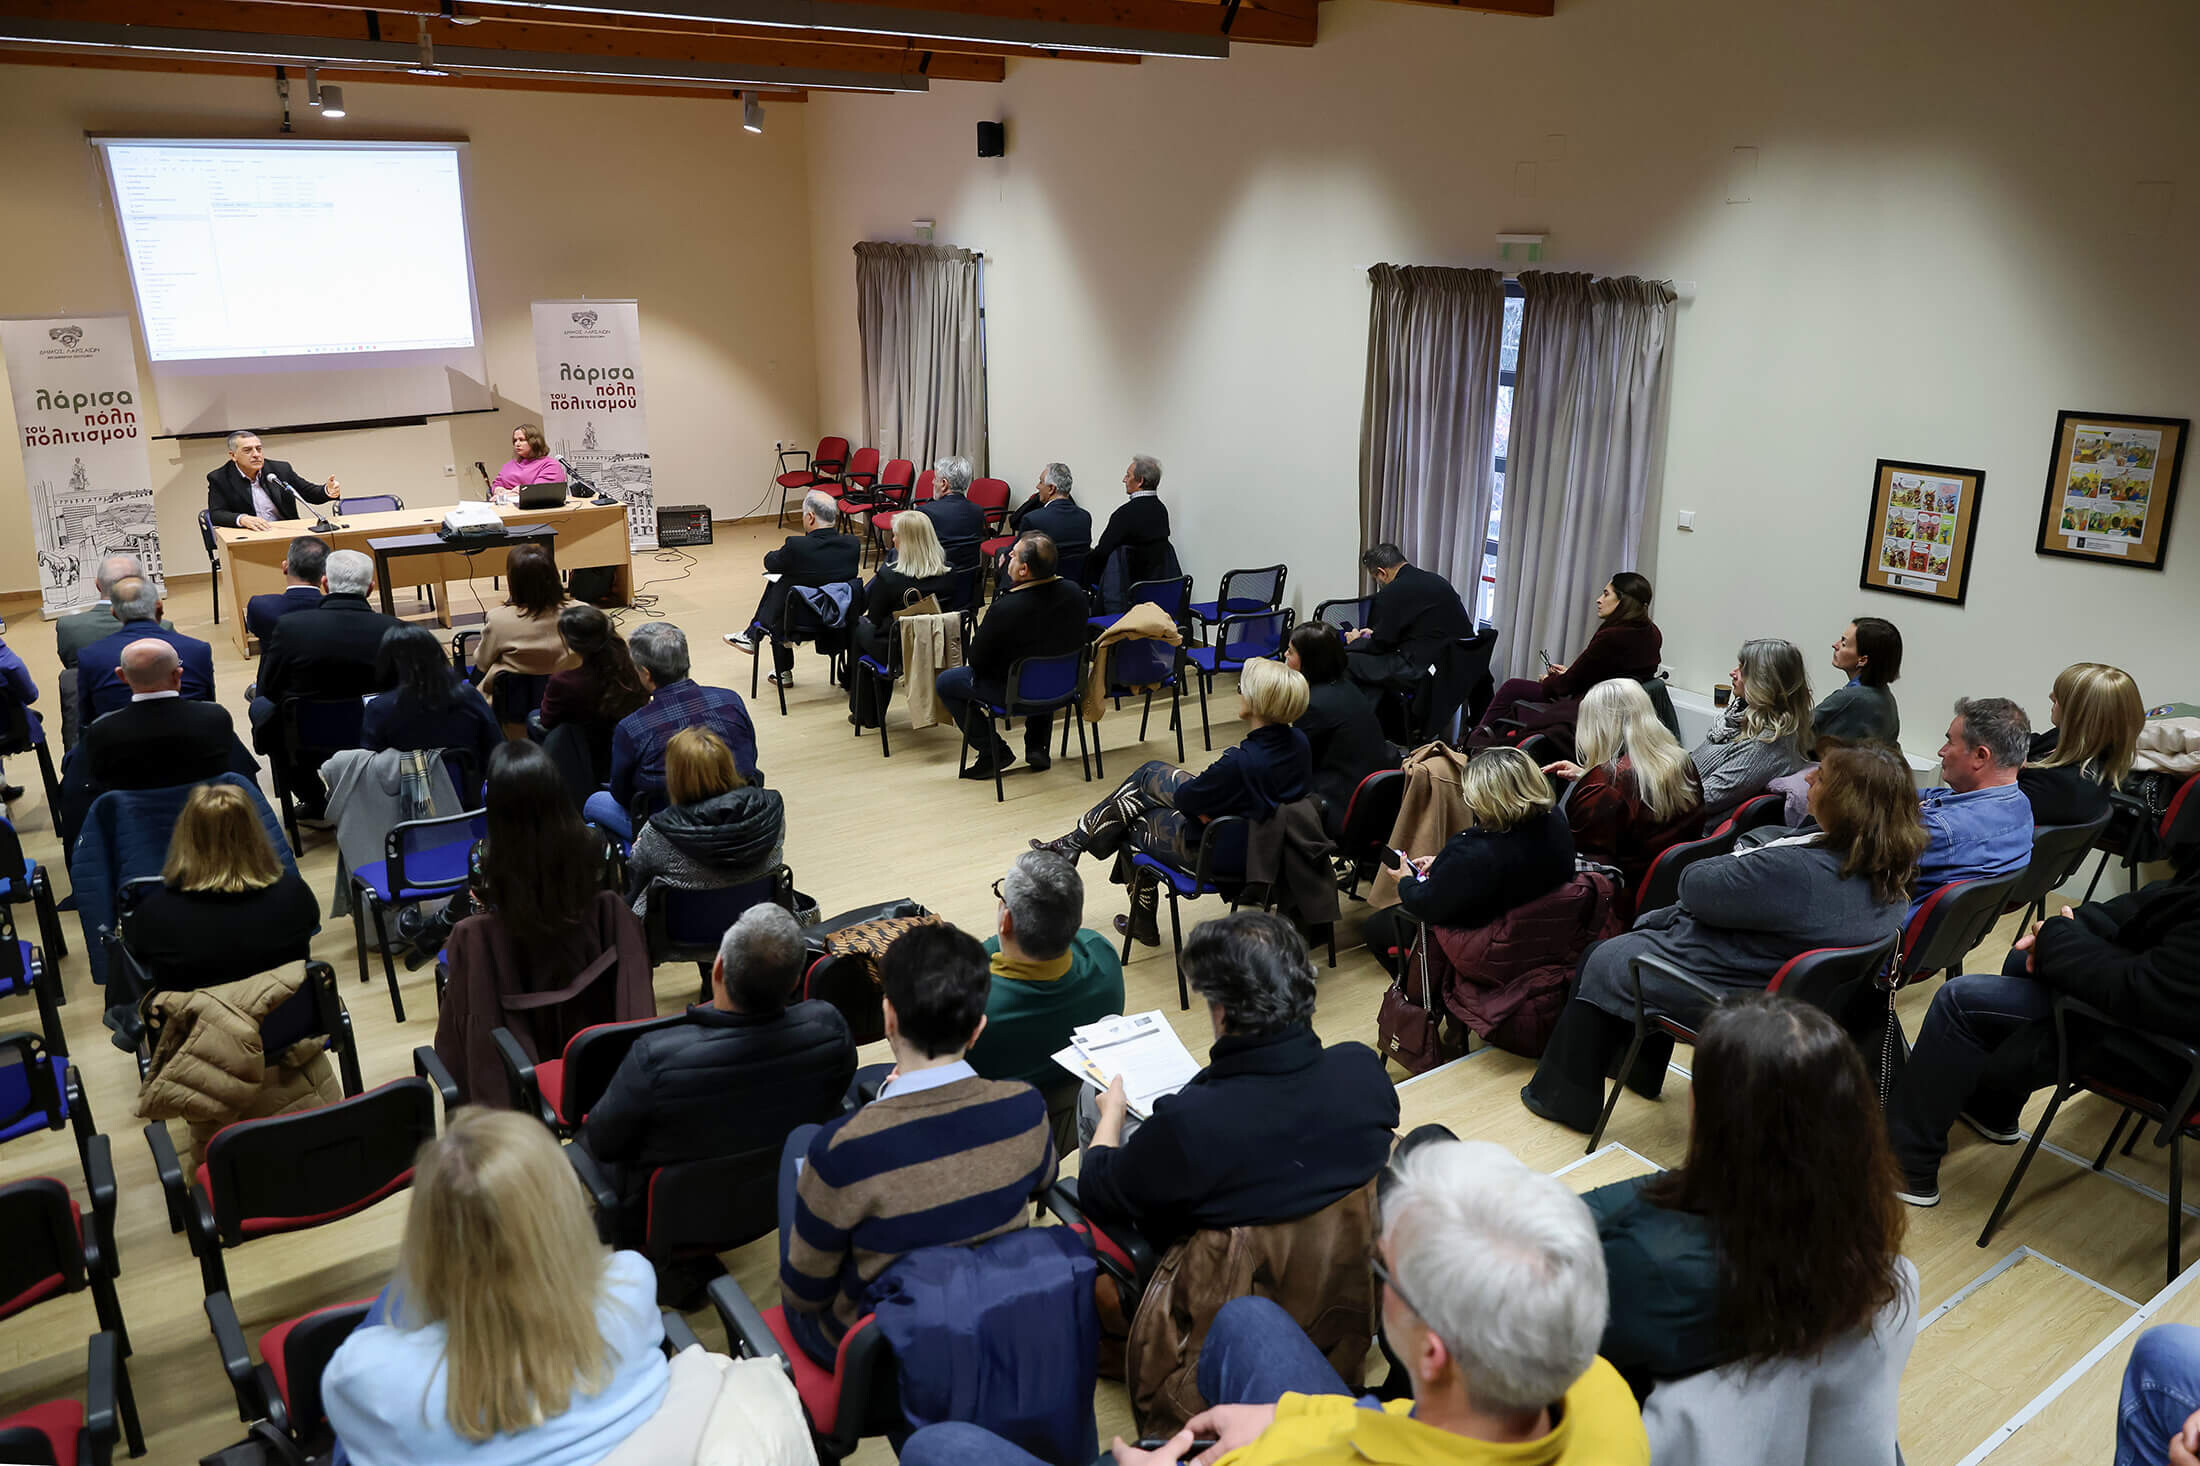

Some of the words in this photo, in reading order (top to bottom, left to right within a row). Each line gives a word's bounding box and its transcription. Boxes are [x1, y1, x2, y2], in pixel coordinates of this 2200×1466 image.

[560, 363, 634, 385] λάρισα
[596, 382, 636, 396] πόλη
[36, 389, 133, 414] λάρισα
[551, 396, 637, 413] πολιτισμού
[84, 408, 136, 427] πόλη
[25, 426, 46, 434] του
[26, 425, 137, 447] πολιτισμού
